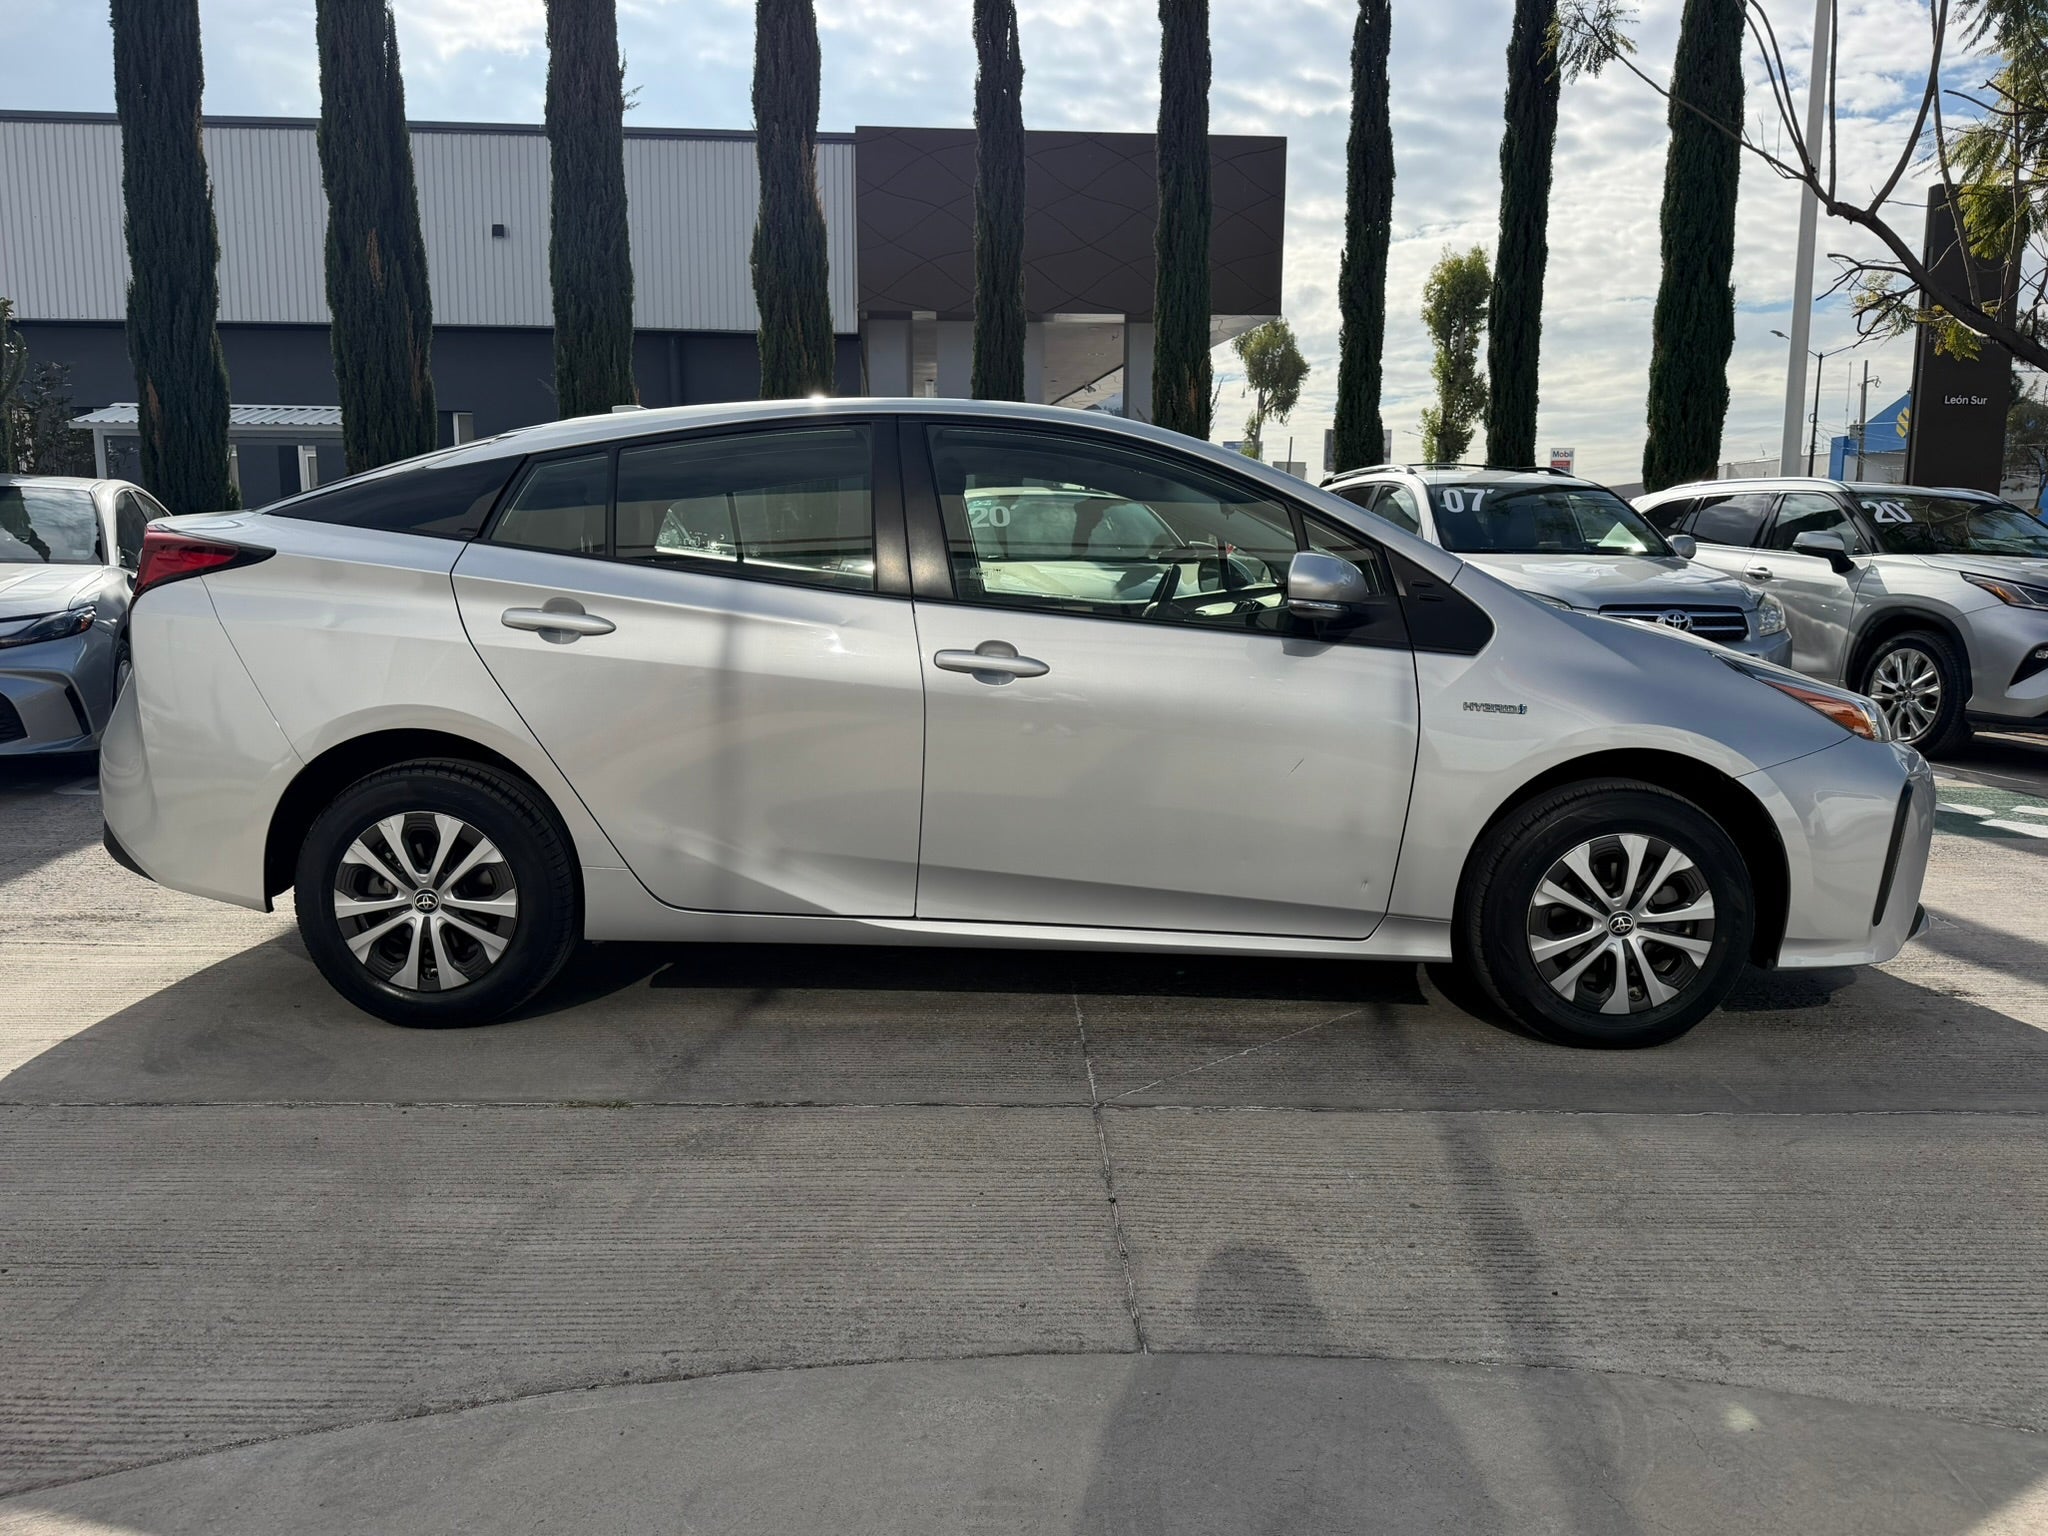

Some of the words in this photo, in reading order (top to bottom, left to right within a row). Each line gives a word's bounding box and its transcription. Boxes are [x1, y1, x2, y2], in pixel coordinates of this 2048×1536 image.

[1944, 394, 1969, 405] León
[1970, 395, 1988, 405] Sur
[1552, 450, 1574, 458] Mobil
[1462, 701, 1518, 714] HYBRID
